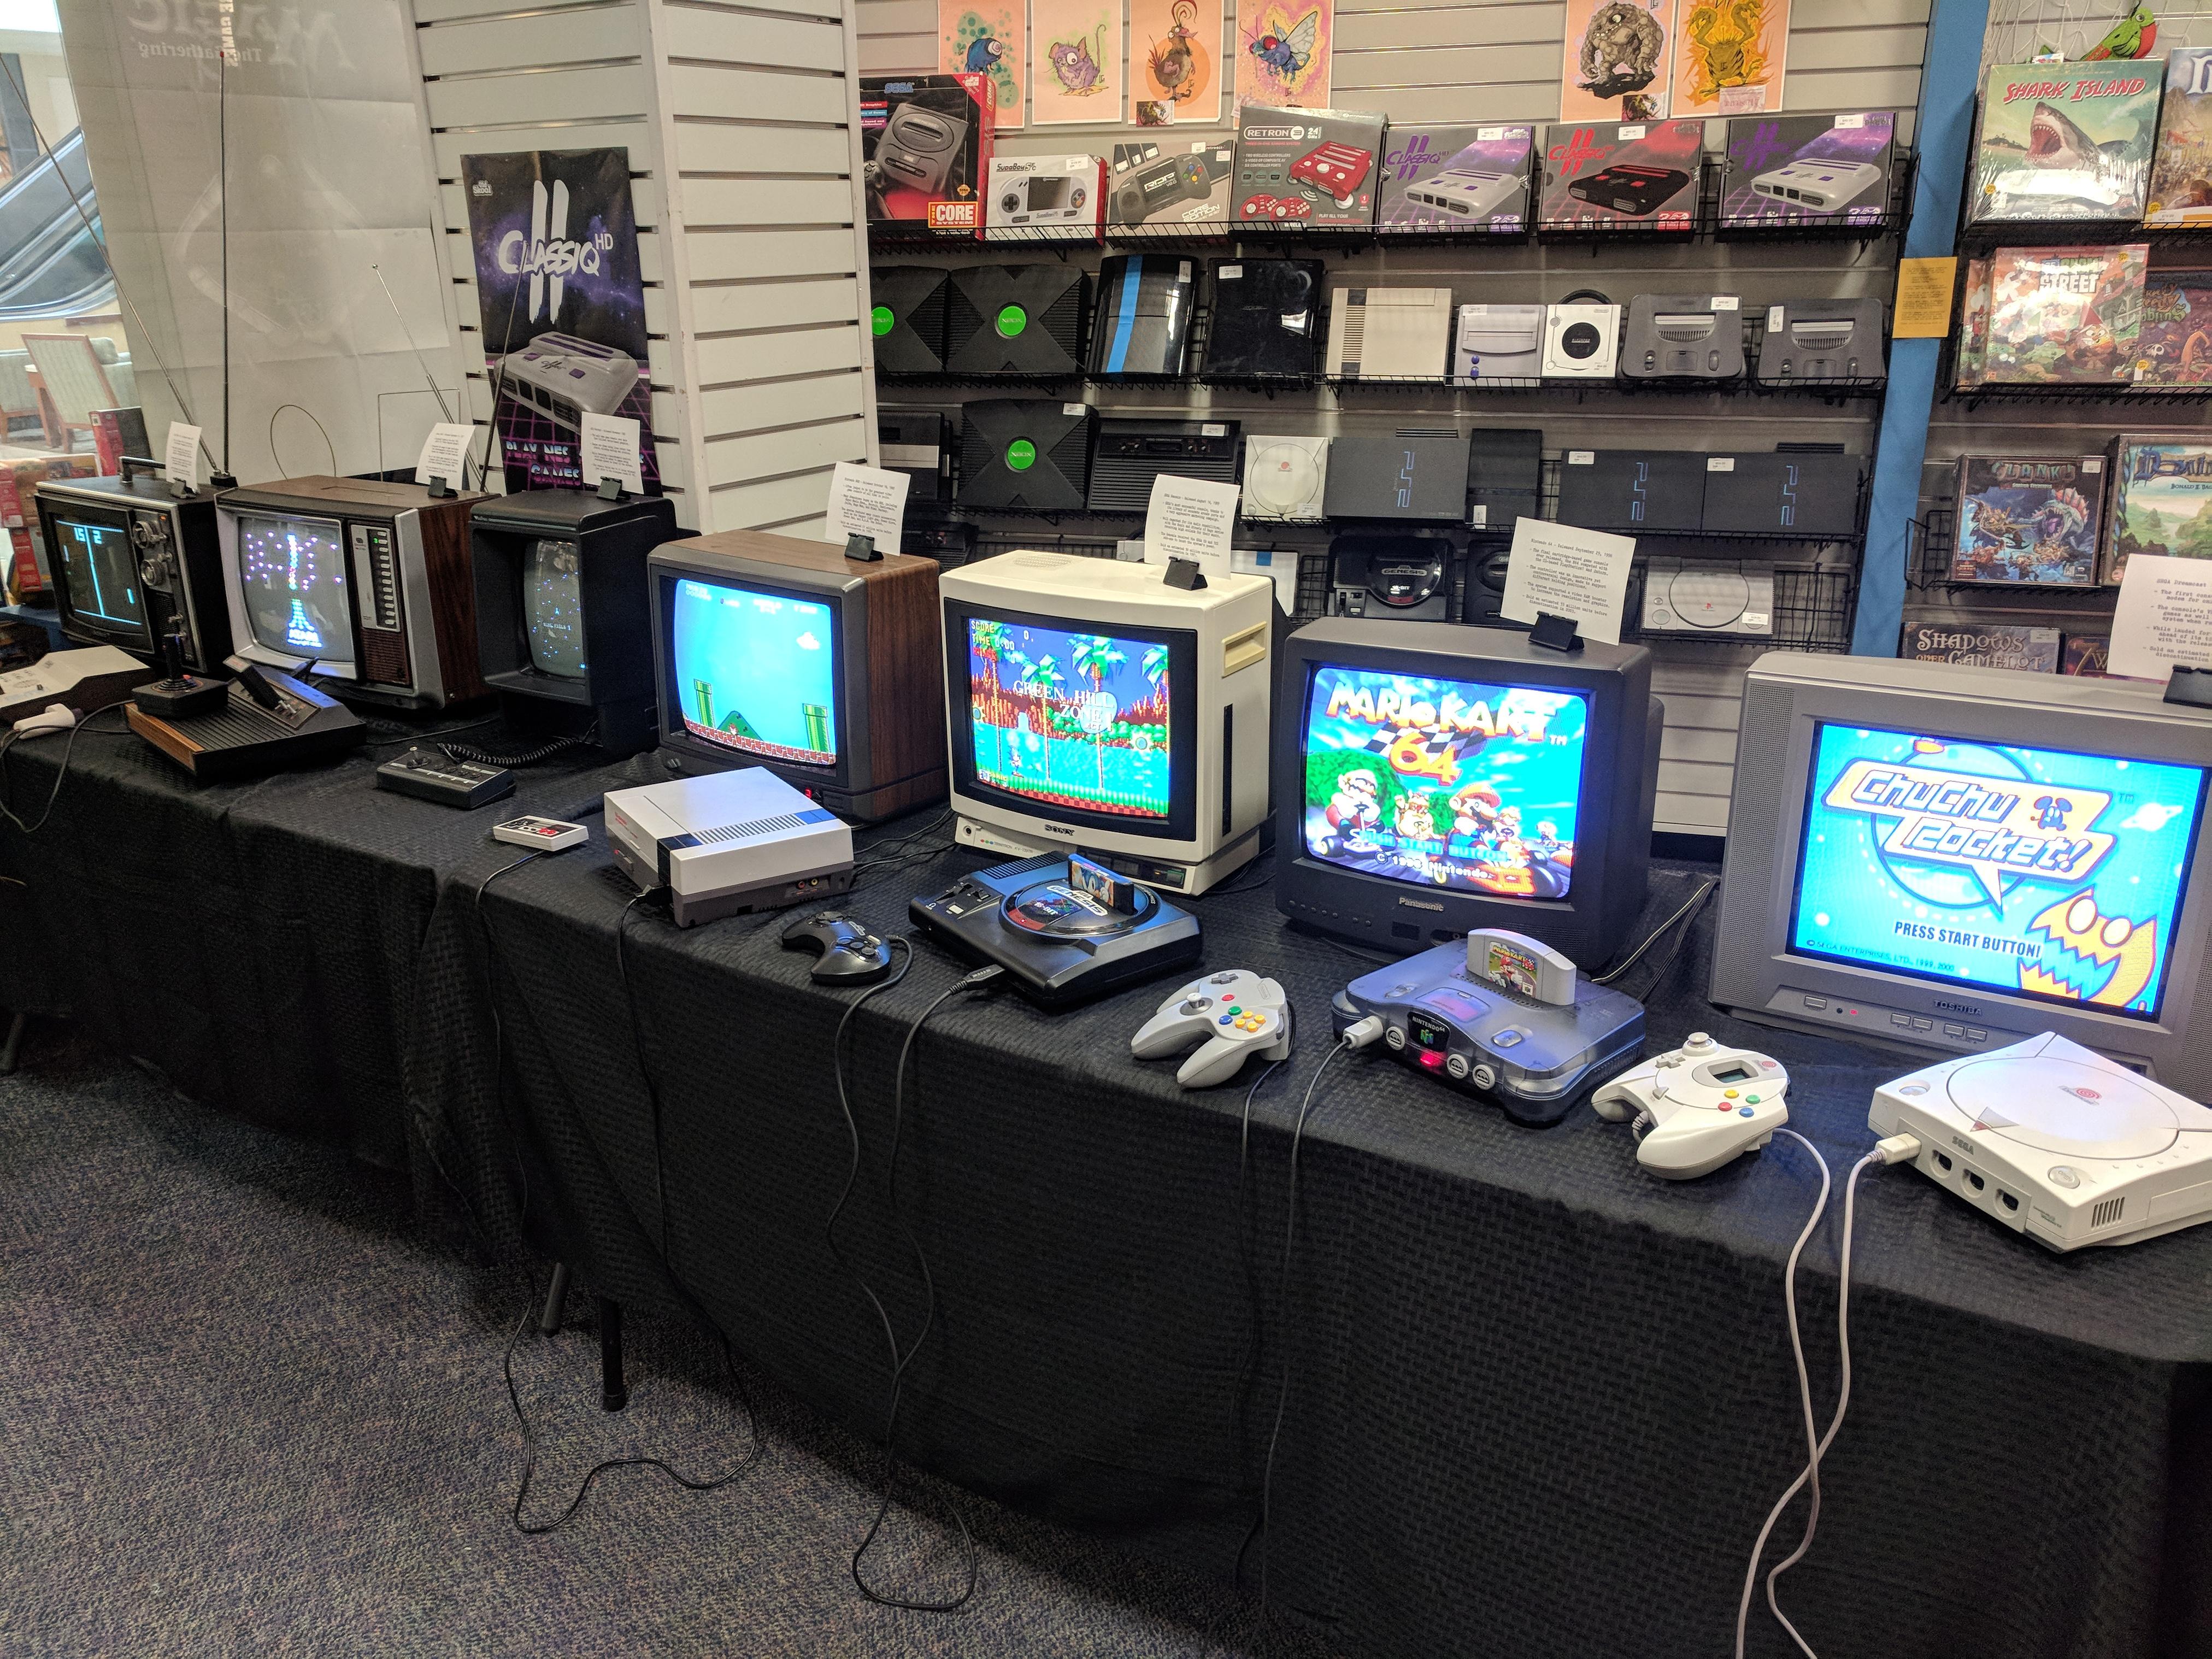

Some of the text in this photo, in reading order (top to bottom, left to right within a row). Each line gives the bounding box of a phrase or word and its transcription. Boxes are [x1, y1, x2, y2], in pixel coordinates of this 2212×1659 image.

[885, 83, 914, 93] SEGA
[2004, 78, 2146, 104] SHARK ISLAND
[473, 185, 492, 195] Skool
[936, 205, 974, 221] CORE
[1182, 203, 1209, 219] CORE
[1183, 204, 1220, 222] EDITION
[498, 230, 614, 276] CLASSIQ HD
[2039, 273, 2099, 293] STREET
[74, 527, 102, 544] 15 2
[971, 620, 1029, 640] SCORE 0
[972, 633, 1015, 651] TIME 0:00
[2156, 652, 2209, 662] discontinuation
[1013, 680, 1111, 708] GREEN HILL
[1060, 704, 1103, 723] ZONE
[1326, 681, 1568, 746] MARIO KART TM
[1390, 732, 1463, 787] 64
[1851, 769, 2022, 823] ChuChu
[1044, 823, 1075, 836] SONY
[1360, 831, 1508, 862] PUSH START BUTTON
[1902, 816, 2093, 873] Rocket!
[1428, 860, 1492, 879] Nintendo
[1052, 886, 1105, 914] GENESIS
[1399, 897, 1444, 912] Panasonic
[1895, 920, 2042, 958] PRESS START BUTTON!
[1817, 941, 1837, 950] SEGA
[1839, 945, 1891, 962] ENTERPRISES,
[1938, 961, 1955, 972] 2000
[1933, 999, 1983, 1016] TOSHIBA
[1952, 1136, 1974, 1156] SEGA
